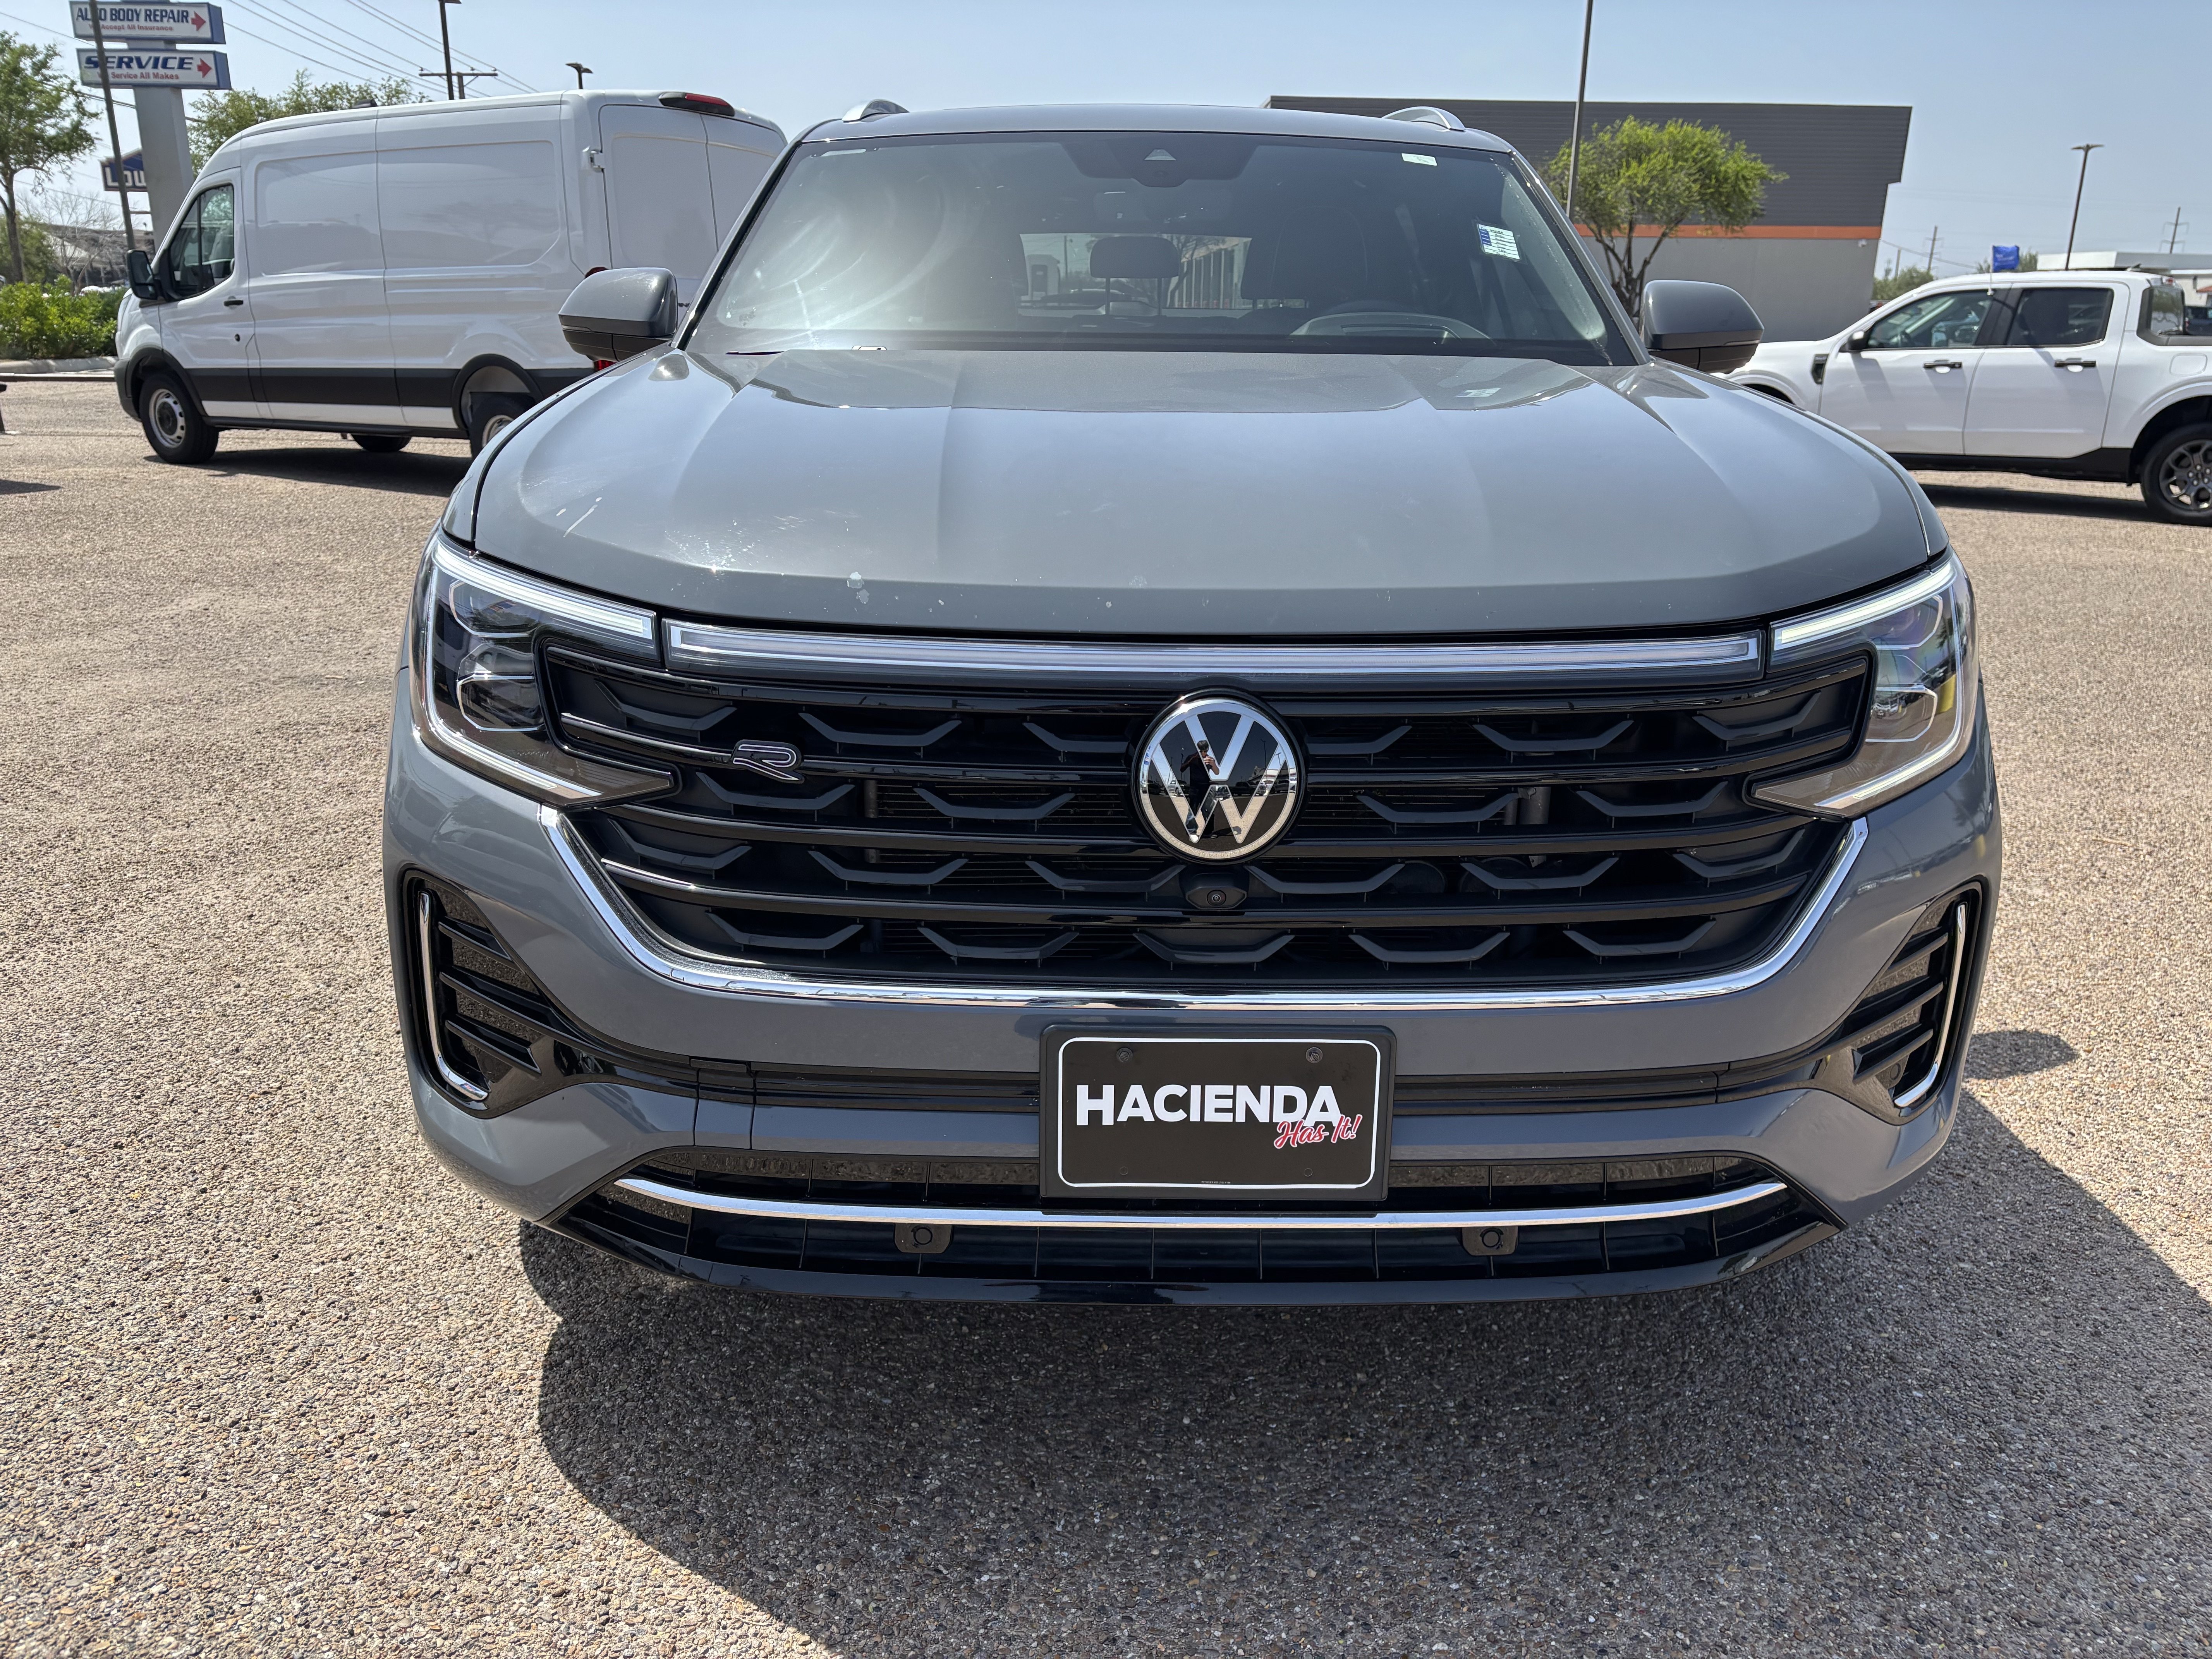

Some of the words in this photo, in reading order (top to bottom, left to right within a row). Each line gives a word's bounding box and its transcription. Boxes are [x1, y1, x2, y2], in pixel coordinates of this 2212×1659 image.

[110, 8, 142, 22] BODY
[144, 9, 189, 23] REPAIR
[84, 56, 193, 70] SERVICE
[1076, 1084, 1342, 1127] HACIENDA
[1273, 1119, 1329, 1149] Has
[1331, 1114, 1363, 1143] It!
